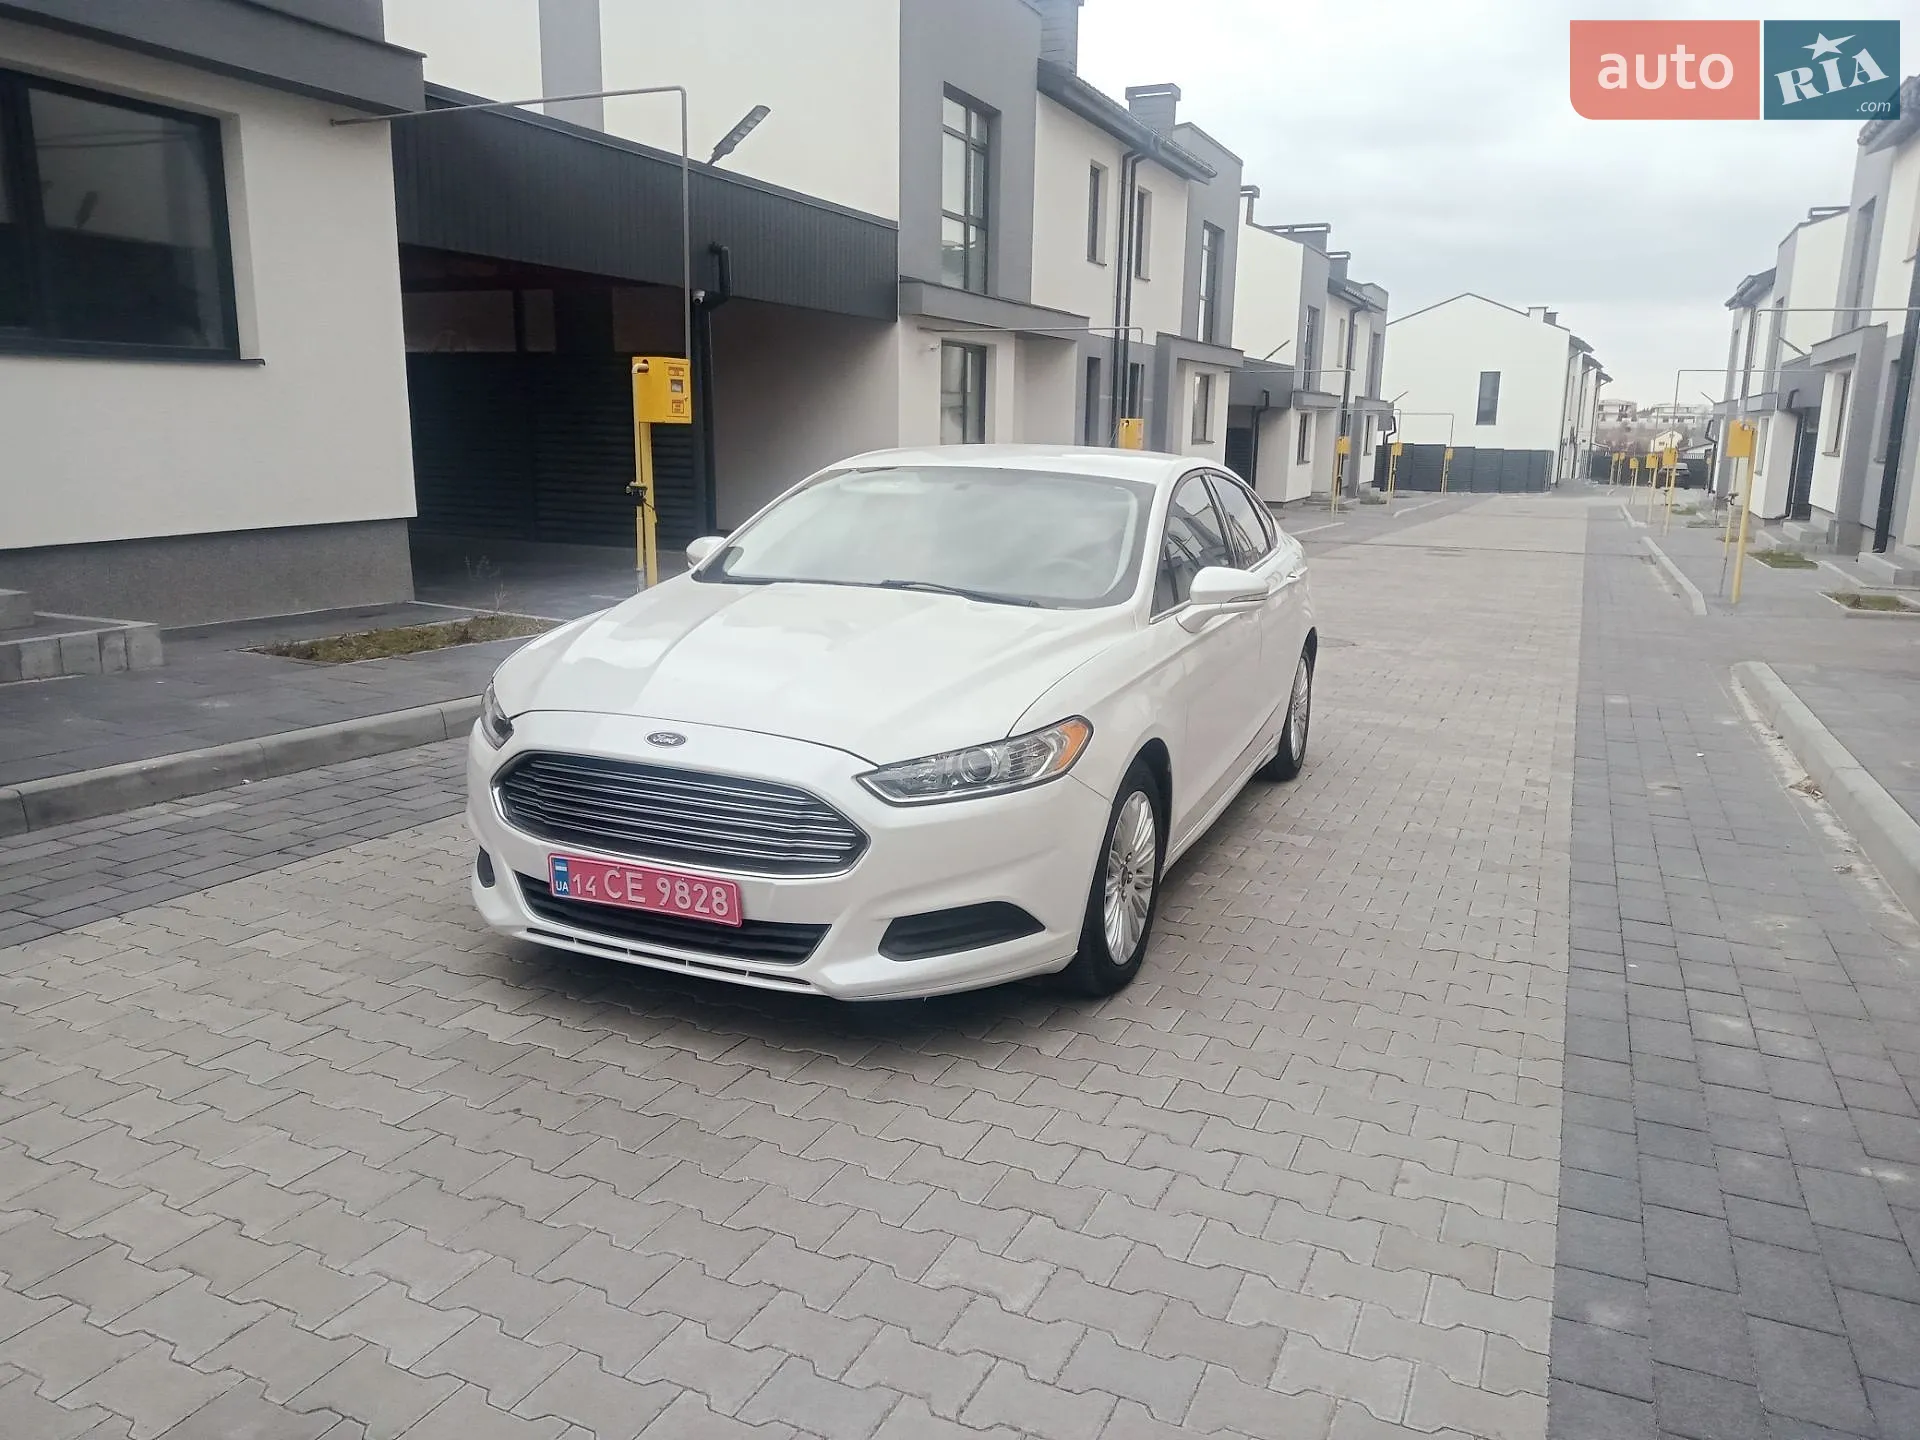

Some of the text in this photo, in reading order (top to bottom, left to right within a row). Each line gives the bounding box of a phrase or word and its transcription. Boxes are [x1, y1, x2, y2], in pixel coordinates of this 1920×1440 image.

[555, 880, 569, 893] UA
[572, 869, 729, 917] 14 CE 9828
